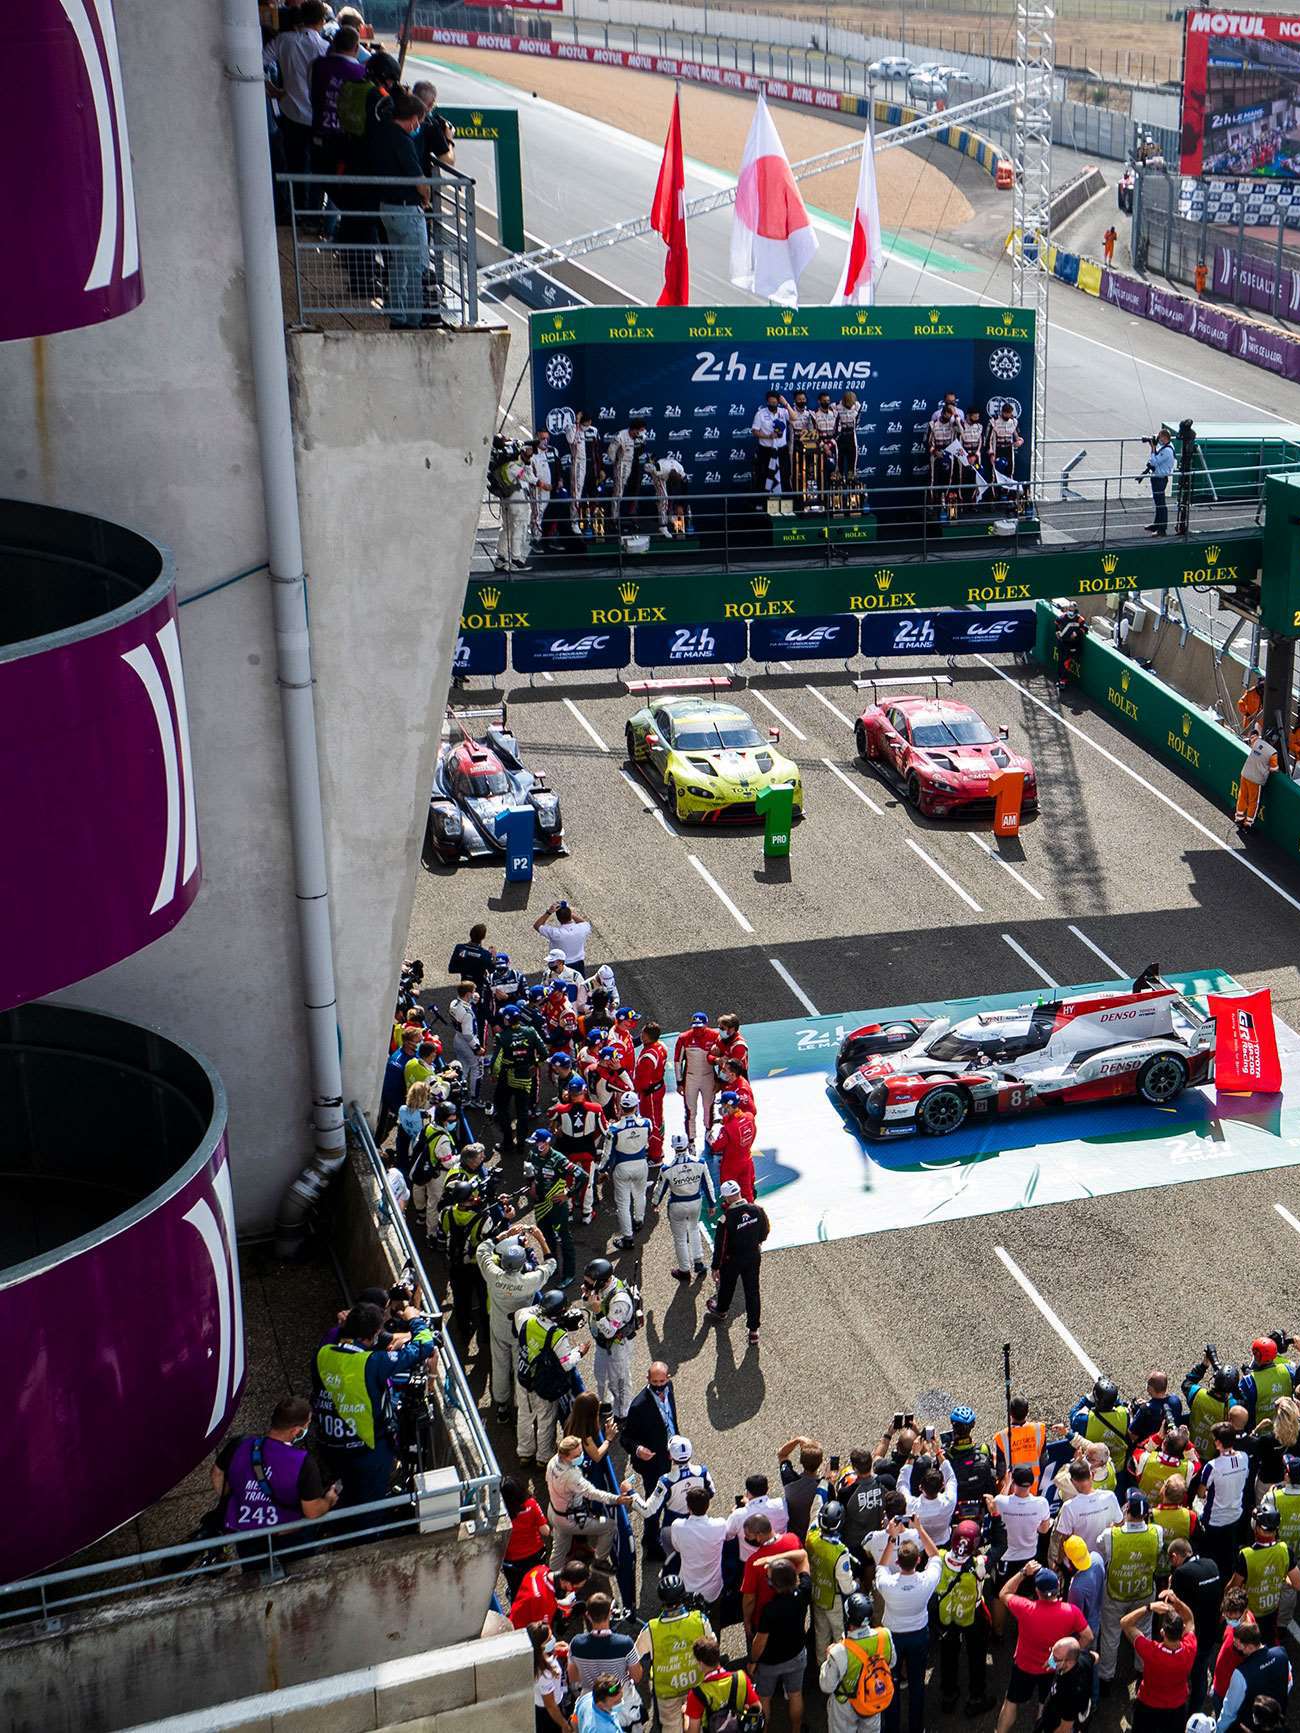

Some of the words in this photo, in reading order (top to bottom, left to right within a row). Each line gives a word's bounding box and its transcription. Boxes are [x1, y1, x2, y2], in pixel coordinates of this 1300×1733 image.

[1190, 13, 1265, 36] MOTUL
[433, 31, 468, 45] MOTUL
[477, 35, 511, 50] MOTUL
[519, 40, 551, 54] MOTUL
[559, 45, 588, 60] MOTUL
[594, 50, 623, 65] MOTUL
[628, 54, 651, 69] MOTUL
[455, 127, 498, 138] ROLEX
[541, 330, 576, 344] ROLEX
[609, 328, 654, 338] ROLEX
[689, 327, 733, 337] ROLEX
[766, 326, 809, 336] ROLEX
[841, 325, 883, 336] ROLEX
[914, 325, 954, 335] ROLEX
[986, 325, 1028, 338] ROLEX
[752, 362, 787, 380] LE
[791, 361, 871, 380] MANS
[771, 382, 793, 391] 19-20
[797, 381, 844, 391] SEPTEMBRE
[846, 381, 866, 390] 2020
[783, 534, 806, 542] ROLEX
[1183, 566, 1238, 584] ROLEX
[1079, 576, 1138, 593] ROLEX
[967, 584, 1032, 601] ROLEX
[724, 599, 797, 618] ROLEX
[850, 593, 917, 610] ROLEX
[591, 607, 667, 624] ROLEX
[893, 641, 904, 649] LE
[906, 640, 933, 648] MANS
[669, 651, 682, 659] LE
[683, 649, 713, 658] MANS
[1107, 687, 1138, 721] ROLEX
[1167, 731, 1200, 769] ROLEX
[1003, 815, 1017, 826] AM
[772, 835, 787, 844] PRO
[513, 858, 528, 869] P2
[1063, 1005, 1075, 1015] HY
[1101, 1011, 1137, 1023] DENSO
[1100, 1060, 1142, 1074] DENSO
[1253, 1043, 1262, 1079] TOYOTA
[1011, 1090, 1022, 1107] 8
[494, 1281, 524, 1294] OFFICIAL
[238, 1505, 279, 1525] 243
[671, 1671, 697, 1688] 460
